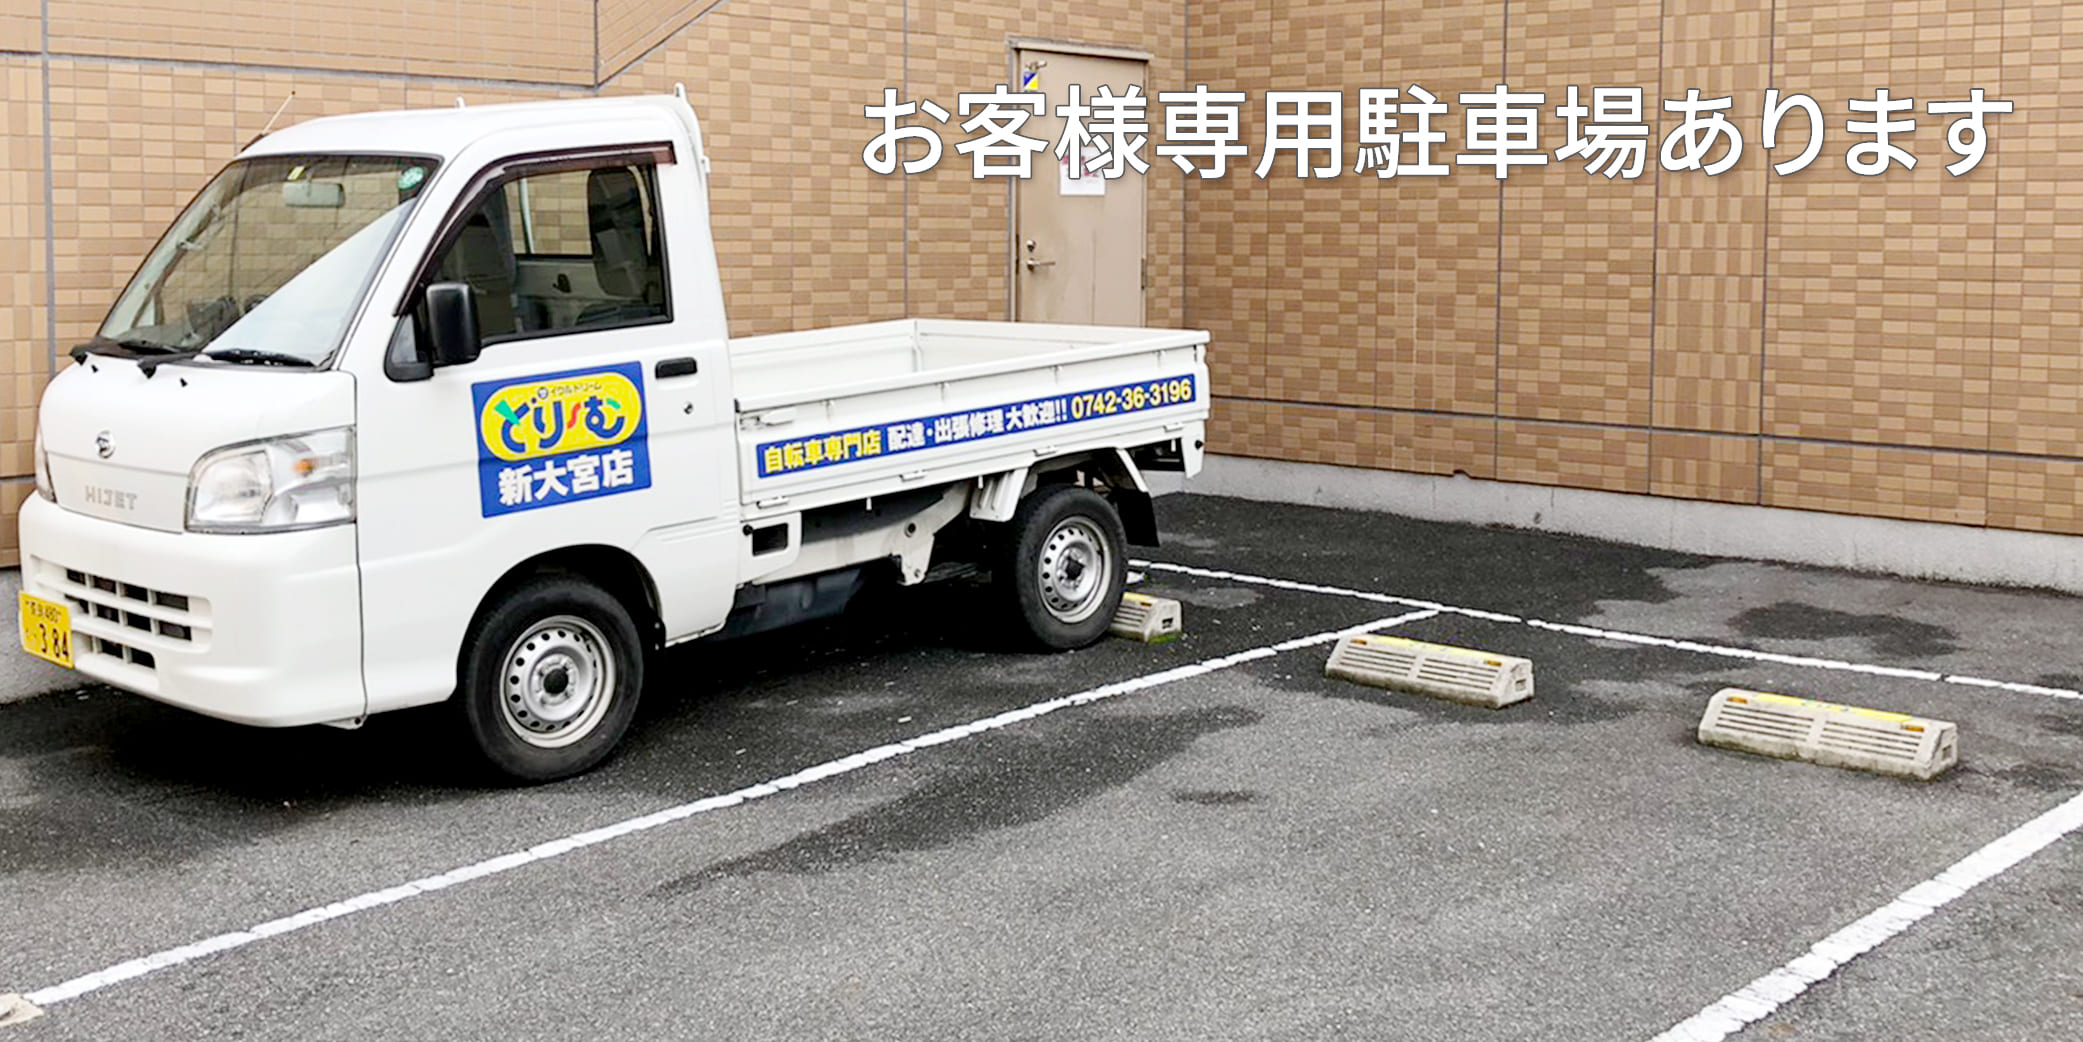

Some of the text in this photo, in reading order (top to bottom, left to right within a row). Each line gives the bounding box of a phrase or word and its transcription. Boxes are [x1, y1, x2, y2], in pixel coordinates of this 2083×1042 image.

[764, 429, 881, 473] 自転車専門店
[1071, 378, 1192, 419] 0742-36-3196
[85, 485, 137, 510] HIJET
[498, 449, 634, 506] 新大宮店
[39, 622, 69, 662] 384
